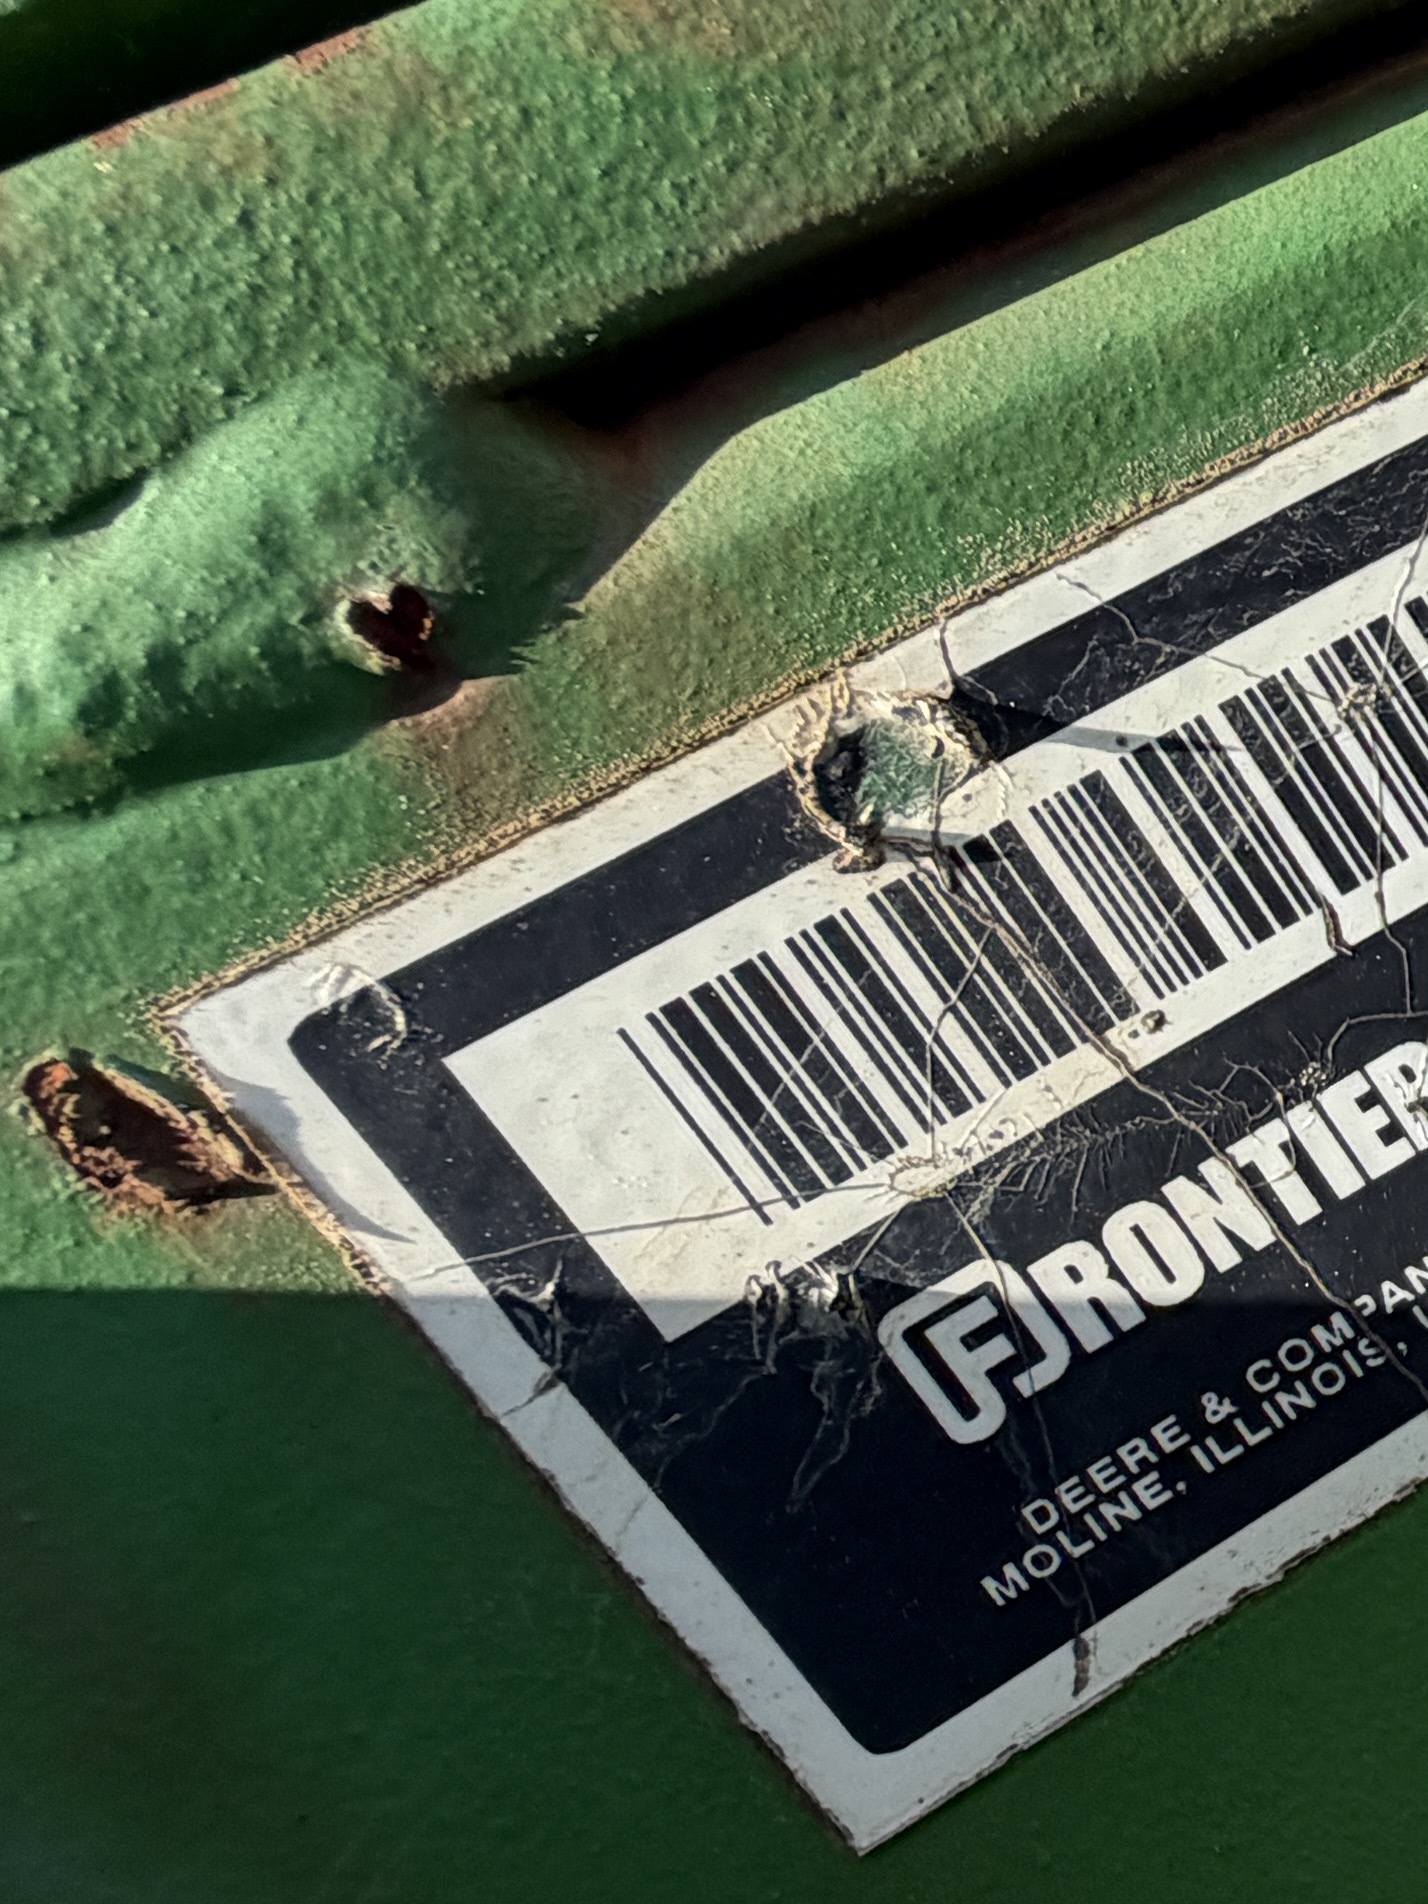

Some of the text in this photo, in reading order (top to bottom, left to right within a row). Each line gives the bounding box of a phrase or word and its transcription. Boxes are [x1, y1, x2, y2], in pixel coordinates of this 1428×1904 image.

[980, 1462, 1188, 1607] MOLINE,
[1197, 1339, 1409, 1476] ILLINOIS,
[1021, 1414, 1191, 1537] DEERE
[1203, 1389, 1238, 1421] &
